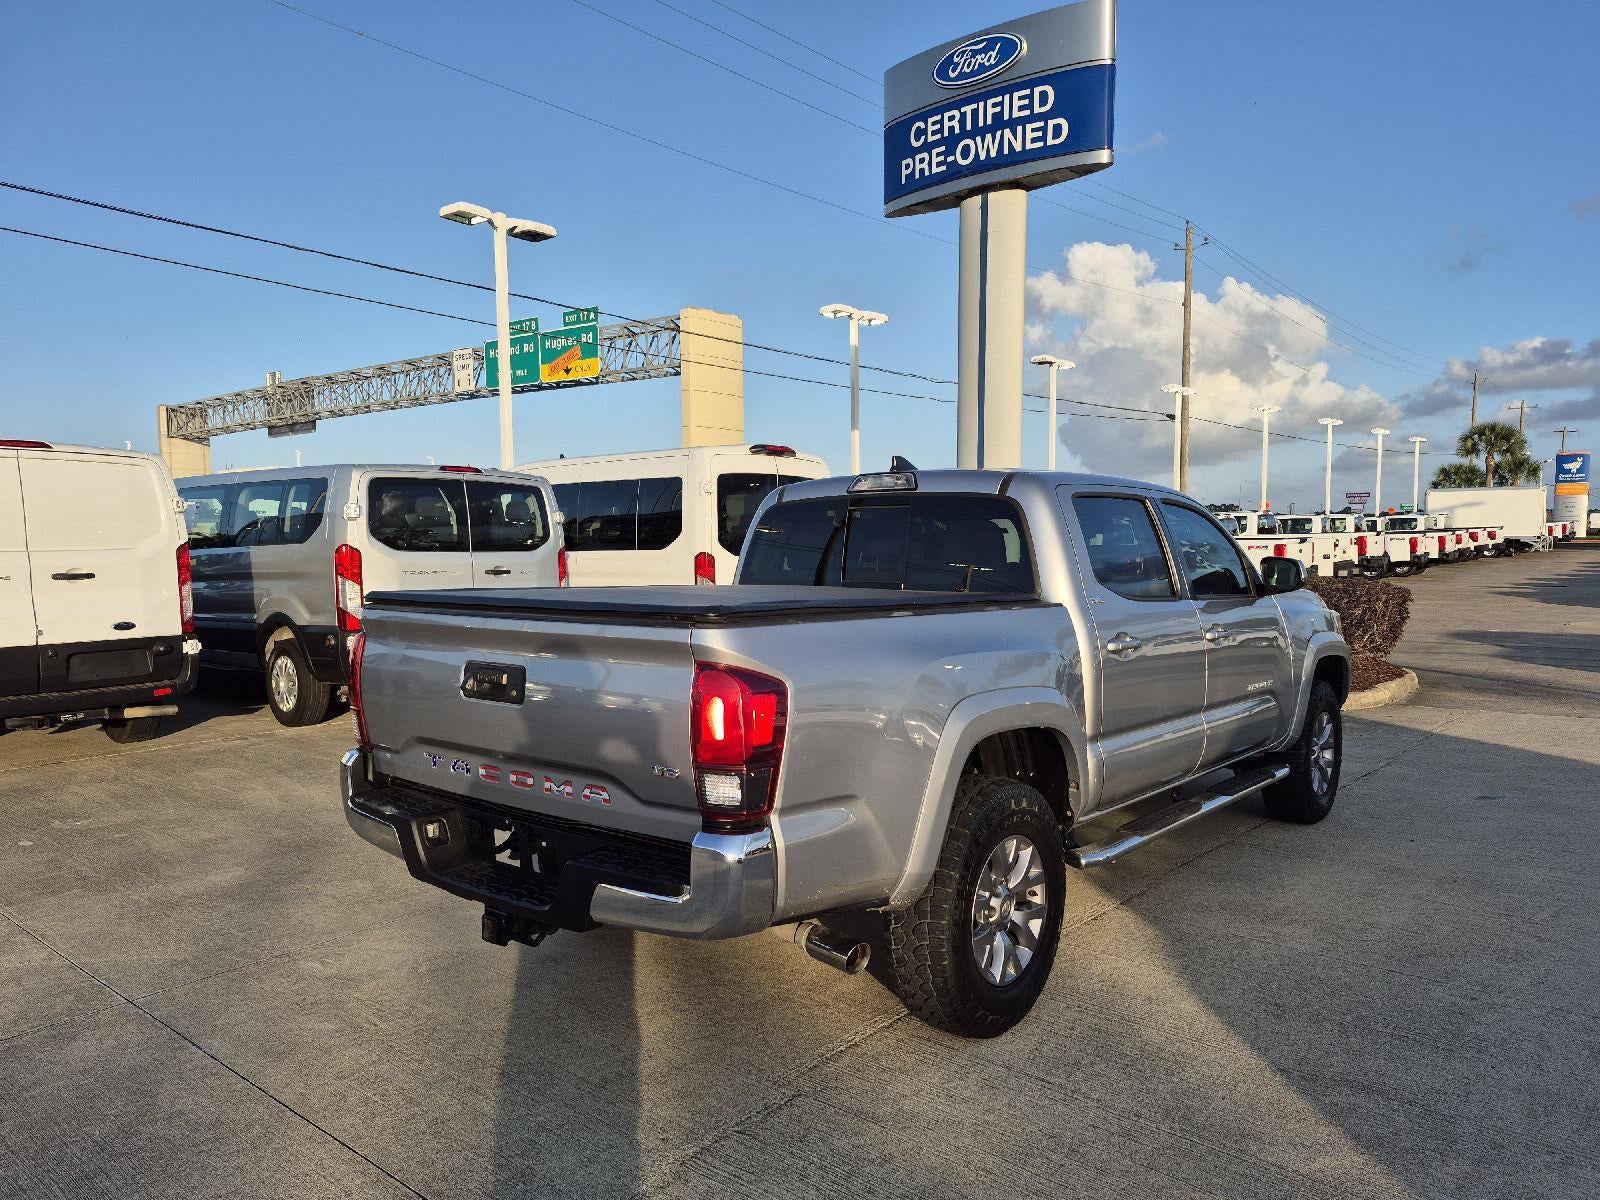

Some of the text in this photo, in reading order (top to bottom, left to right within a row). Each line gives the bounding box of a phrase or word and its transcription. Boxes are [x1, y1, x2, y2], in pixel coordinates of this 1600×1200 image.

[948, 41, 1001, 79] Ford
[910, 84, 1055, 149] CERTIFIED
[901, 117, 1069, 185] PRE-OWNED
[522, 322, 530, 331] 17
[532, 320, 536, 330] B
[565, 311, 596, 322] EXIT 17 A
[523, 342, 534, 354] Rd
[581, 332, 593, 344] Rd
[423, 751, 611, 806] TACOMA
